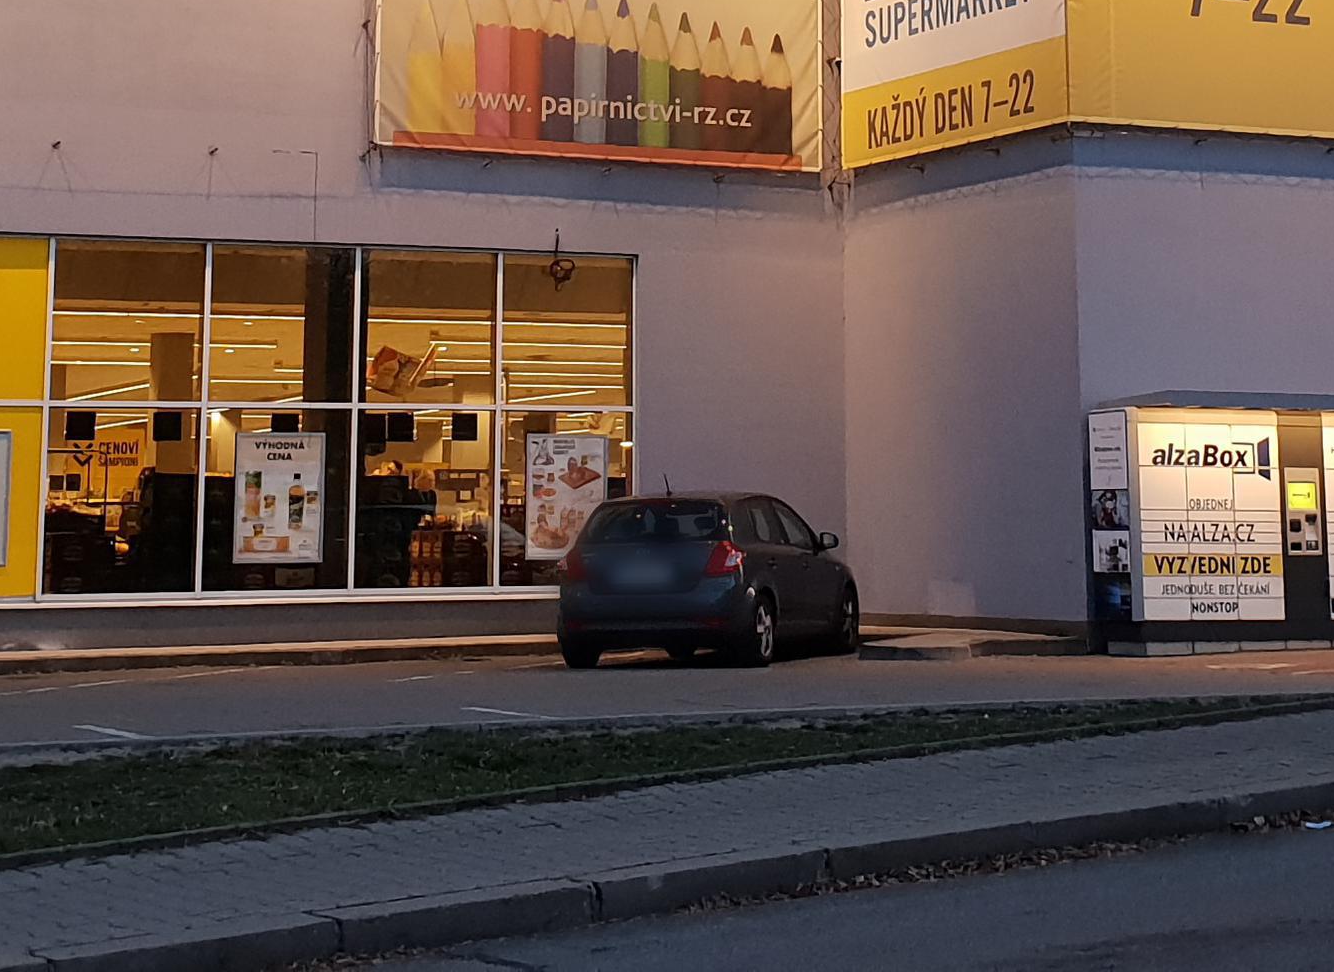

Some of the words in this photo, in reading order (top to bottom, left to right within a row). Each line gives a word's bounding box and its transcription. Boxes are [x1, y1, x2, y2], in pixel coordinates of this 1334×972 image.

[540, 93, 752, 128] papirnictvi-rz.cz
[867, 87, 927, 149] KAŽDÝ
[935, 84, 973, 135] DEN
[99, 439, 139, 455] CENOVÍ
[255, 439, 305, 450] VÝHODNÁ
[267, 452, 293, 461] CENA
[1152, 443, 1248, 467] alzaBox
[1189, 498, 1233, 510] OBJEDNEJ
[1164, 523, 1187, 542] NA
[1191, 523, 1255, 542] ALZA.CZ
[1240, 556, 1272, 575] ZDE
[1161, 582, 1214, 595] JEDNODUŠE
[1219, 584, 1235, 595] BEZ
[1238, 581, 1270, 595] ČEKÁNÍ
[1192, 601, 1239, 614] NONSTOP
